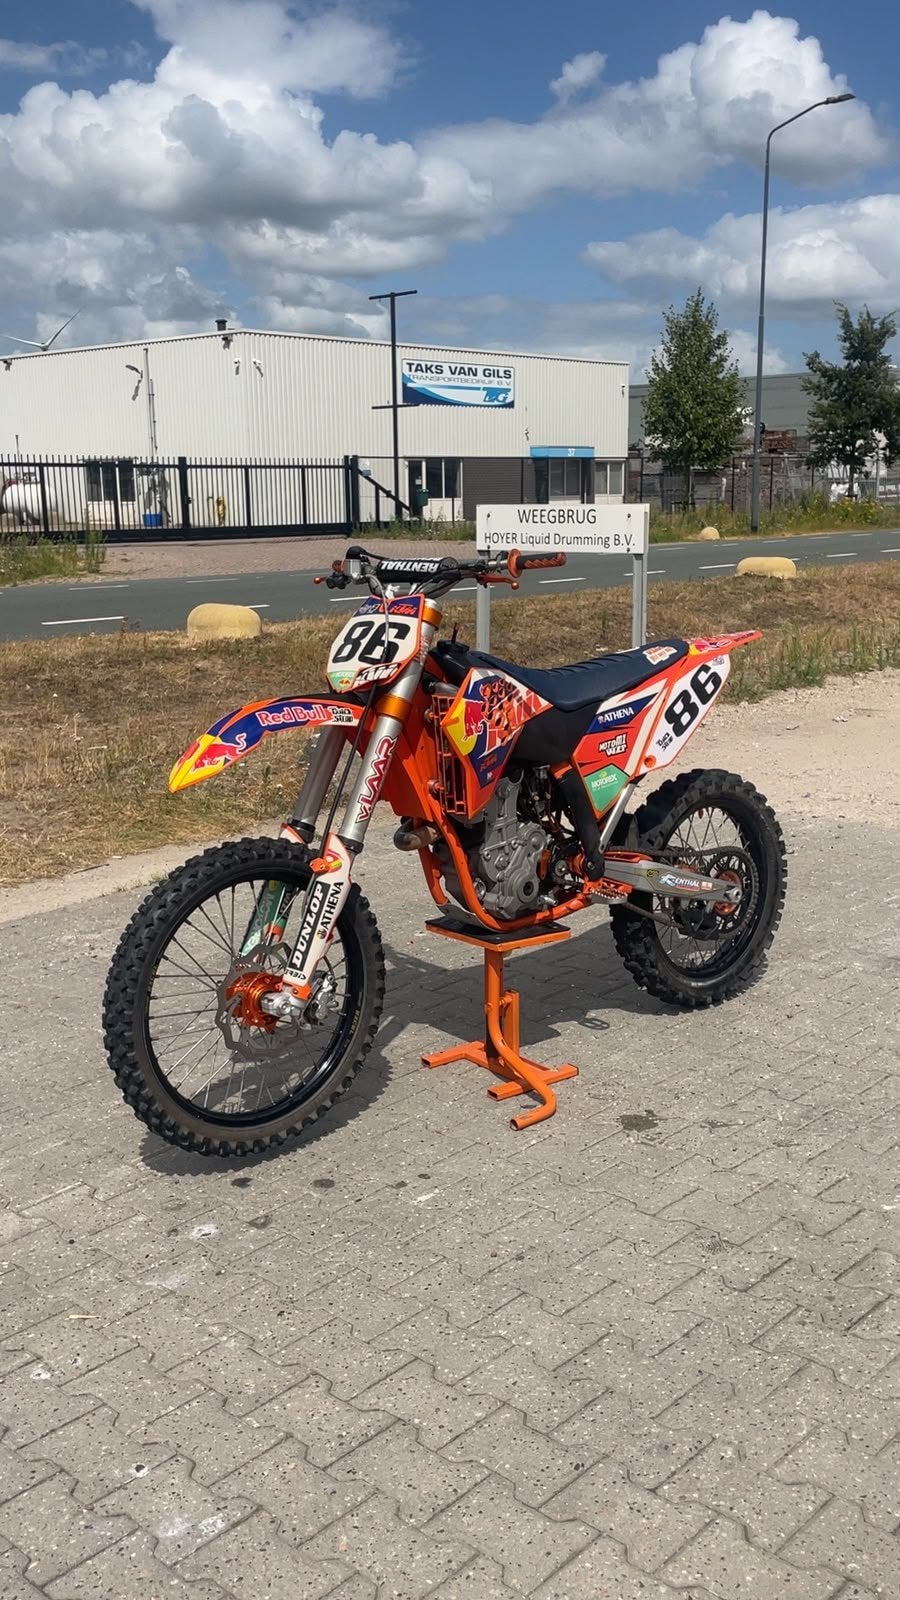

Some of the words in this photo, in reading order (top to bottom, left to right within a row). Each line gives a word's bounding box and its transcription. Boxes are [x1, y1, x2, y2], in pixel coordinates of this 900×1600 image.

[406, 362, 443, 374] TAKS
[449, 365, 478, 377] VAN
[483, 368, 512, 379] GILS
[517, 508, 597, 524] WEEGBRUG
[484, 532, 518, 544] HOYER
[520, 533, 550, 547] Liquid
[553, 533, 610, 548] Drumming
[613, 534, 635, 546] B.V.
[381, 560, 440, 573] RENTHAL
[332, 620, 411, 666] 86
[664, 664, 722, 738] 86
[256, 707, 294, 726] Red
[292, 705, 326, 721] Bull
[604, 707, 635, 722] ATHENA
[323, 881, 344, 931] ATHENA
[291, 883, 324, 970] DUNLOP
